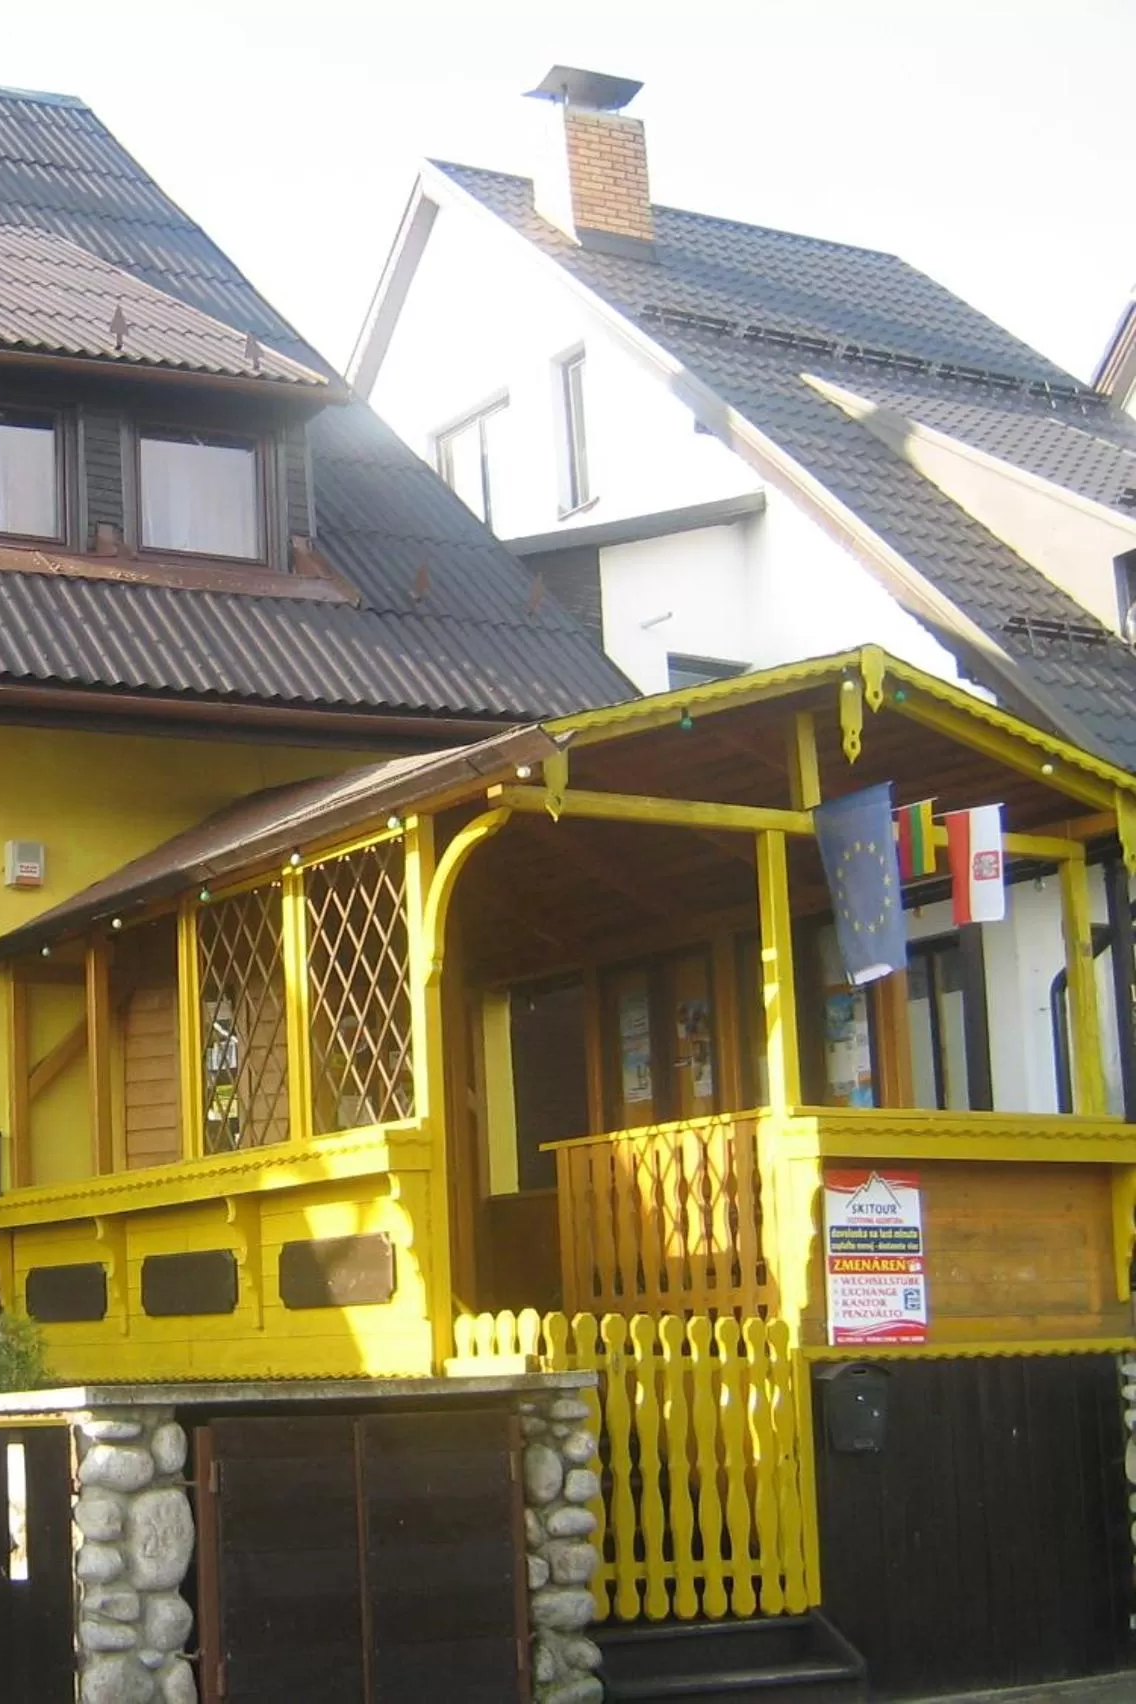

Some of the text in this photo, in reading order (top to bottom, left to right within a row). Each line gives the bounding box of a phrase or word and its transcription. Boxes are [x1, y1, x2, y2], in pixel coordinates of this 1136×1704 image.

[834, 1255, 906, 1271] ZMENÁREŇ
[841, 1287, 897, 1296] EXCHANGE
[842, 1298, 886, 1307] KANTOR
